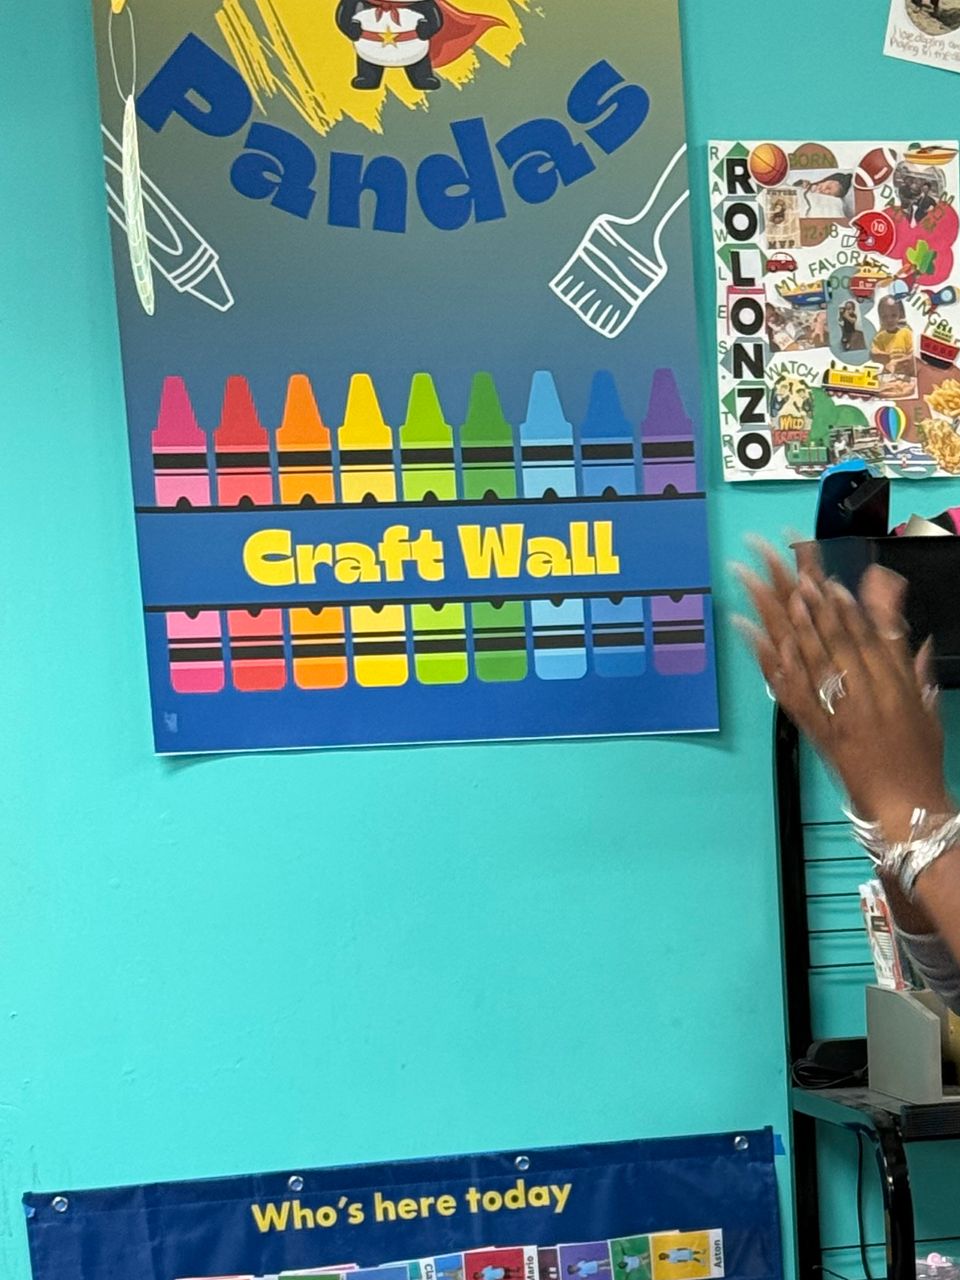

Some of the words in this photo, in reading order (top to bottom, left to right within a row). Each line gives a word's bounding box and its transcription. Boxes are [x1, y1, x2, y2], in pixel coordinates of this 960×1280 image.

[137, 32, 650, 233] Pandas
[764, 361, 819, 384] WATCH
[242, 525, 446, 586] Craft
[457, 520, 621, 579] Wall
[250, 1195, 365, 1233] Who's
[374, 1192, 458, 1222] here
[465, 1178, 572, 1214] today
[713, 1239, 722, 1269] Aston
